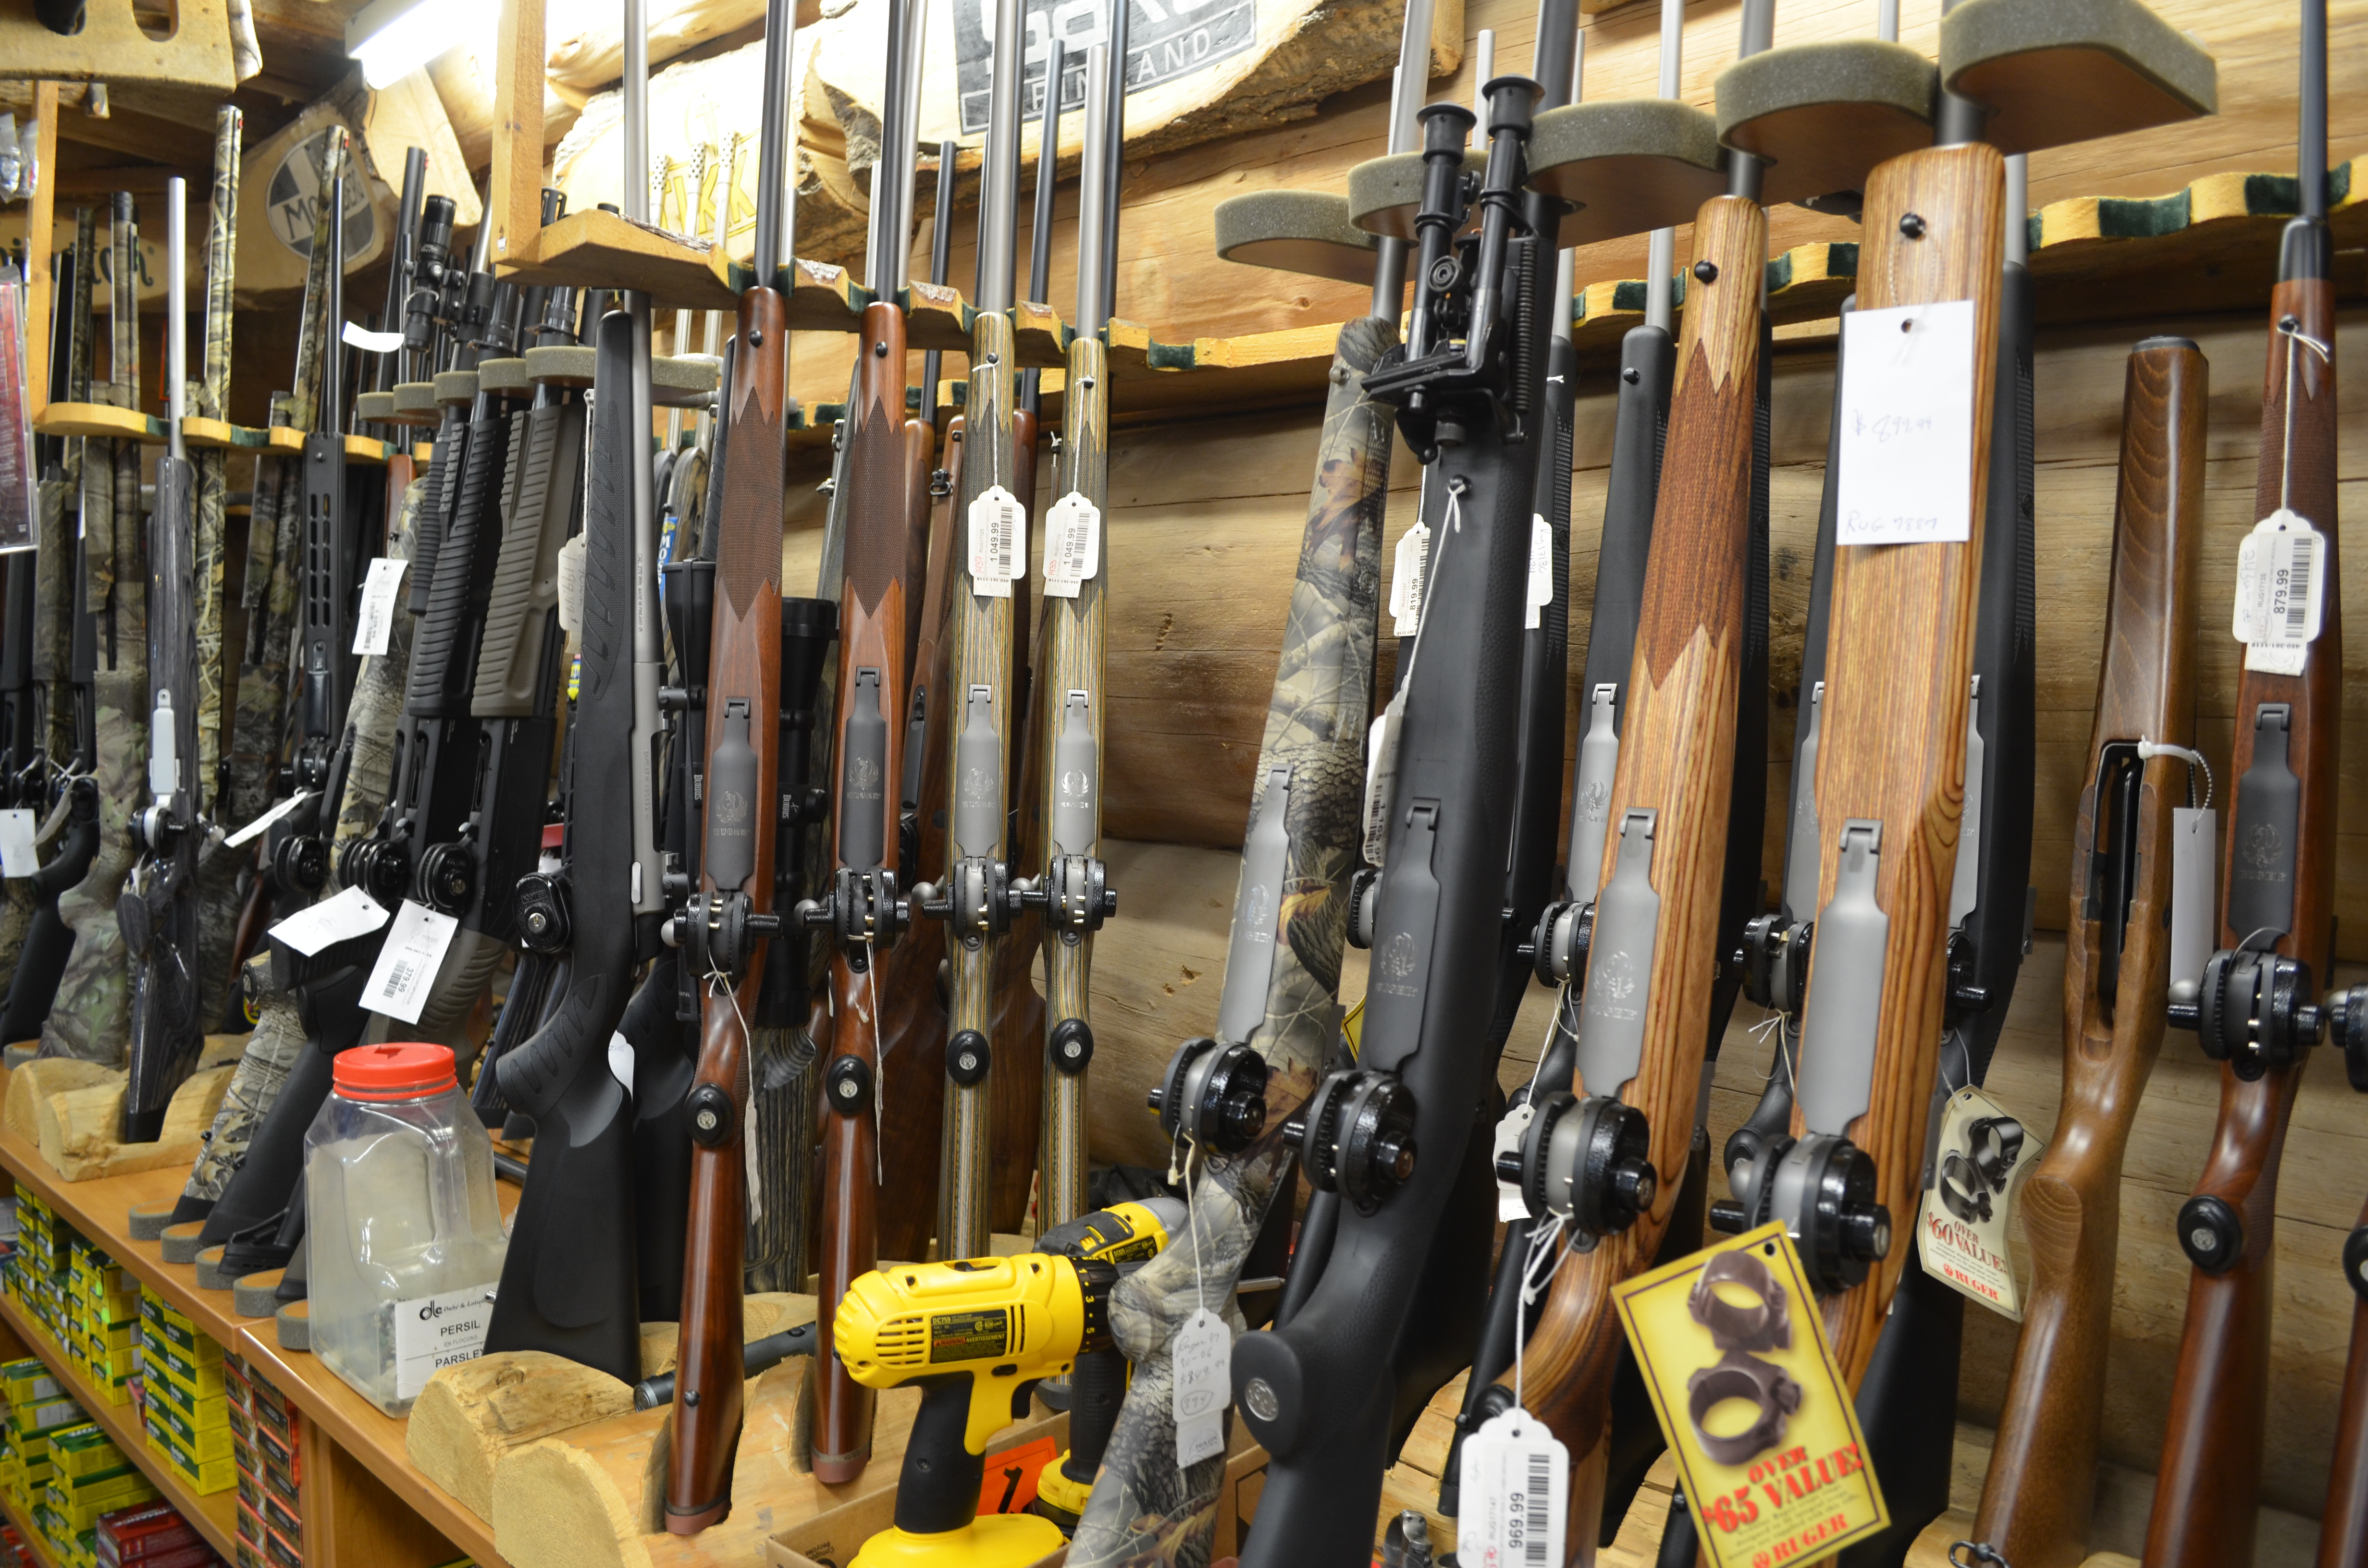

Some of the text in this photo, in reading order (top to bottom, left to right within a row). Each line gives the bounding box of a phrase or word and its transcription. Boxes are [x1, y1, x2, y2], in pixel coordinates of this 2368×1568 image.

[1031, 27, 1212, 110] FINAND
[1409, 578, 1419, 611] 819.99
[2257, 573, 2267, 608] RUG17135
[2273, 569, 2290, 614] 879.99
[693, 774, 703, 800] BURRIS
[782, 794, 791, 819] BURRIS
[397, 968, 414, 993] 379.99
[1927, 1212, 1953, 1246] $60
[1954, 1221, 1979, 1242] OVER
[1085, 1295, 1095, 1303] 3
[1955, 1269, 1999, 1301] RUGER
[441, 1320, 481, 1337] PERSIL
[453, 1335, 478, 1344] FLOCONS
[966, 1334, 1005, 1343] AVERTISSEMENT
[1748, 1445, 1808, 1484] OVER
[1701, 1441, 1863, 1533] $65 VALUE!
[1509, 1492, 1525, 1549] 969.99
[1772, 1513, 1849, 1563] RUGER
